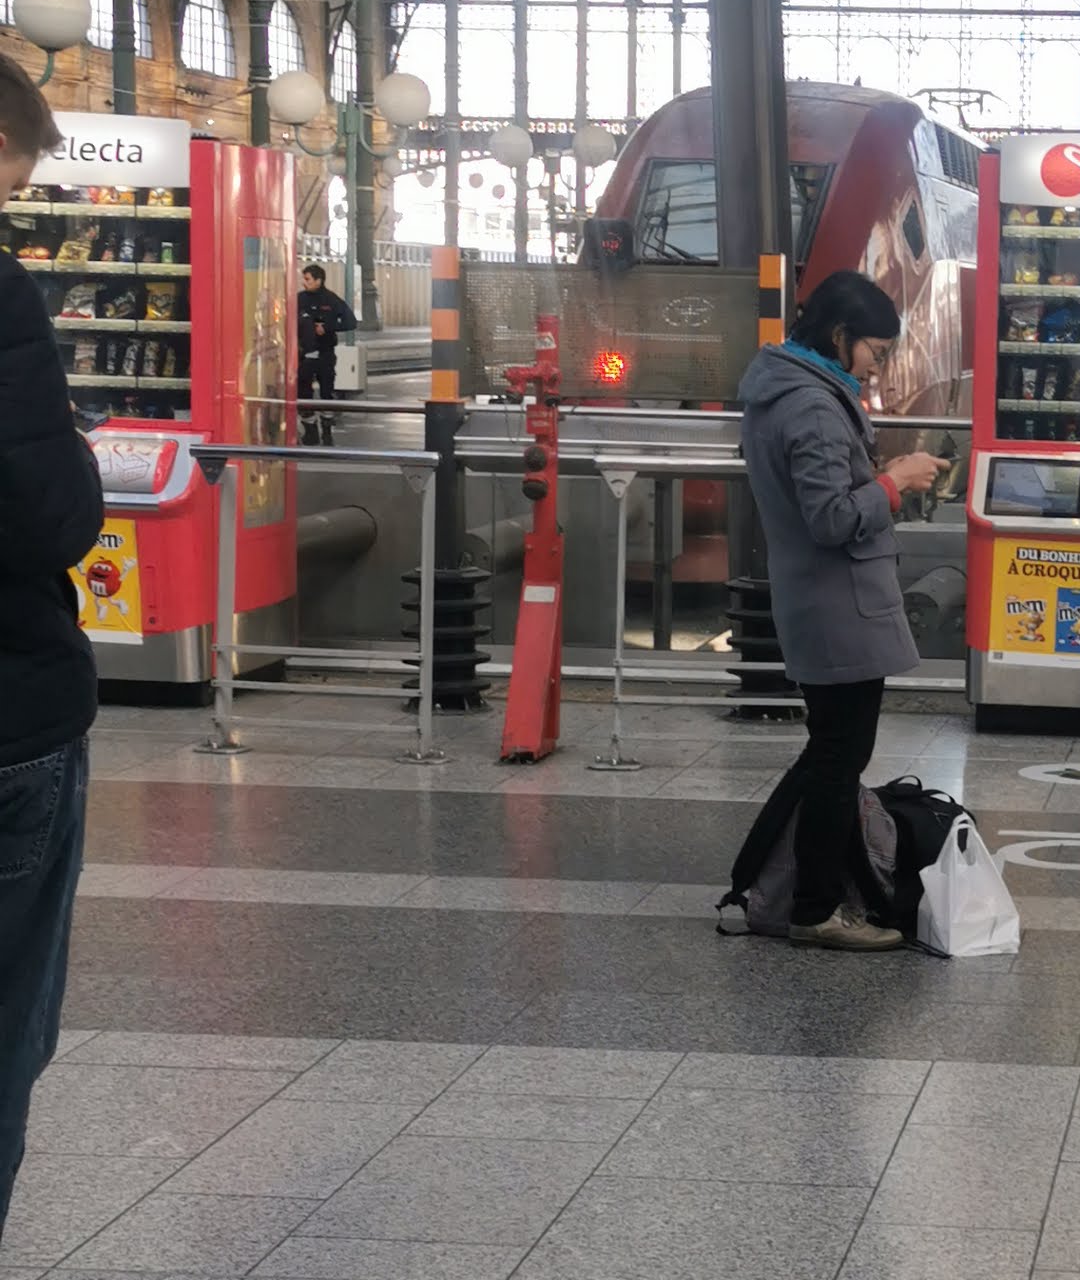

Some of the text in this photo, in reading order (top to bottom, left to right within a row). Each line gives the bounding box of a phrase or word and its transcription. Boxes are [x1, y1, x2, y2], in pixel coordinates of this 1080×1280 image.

[51, 136, 143, 163] electa
[1018, 547, 1038, 561] DU
[1007, 558, 1021, 576] À
